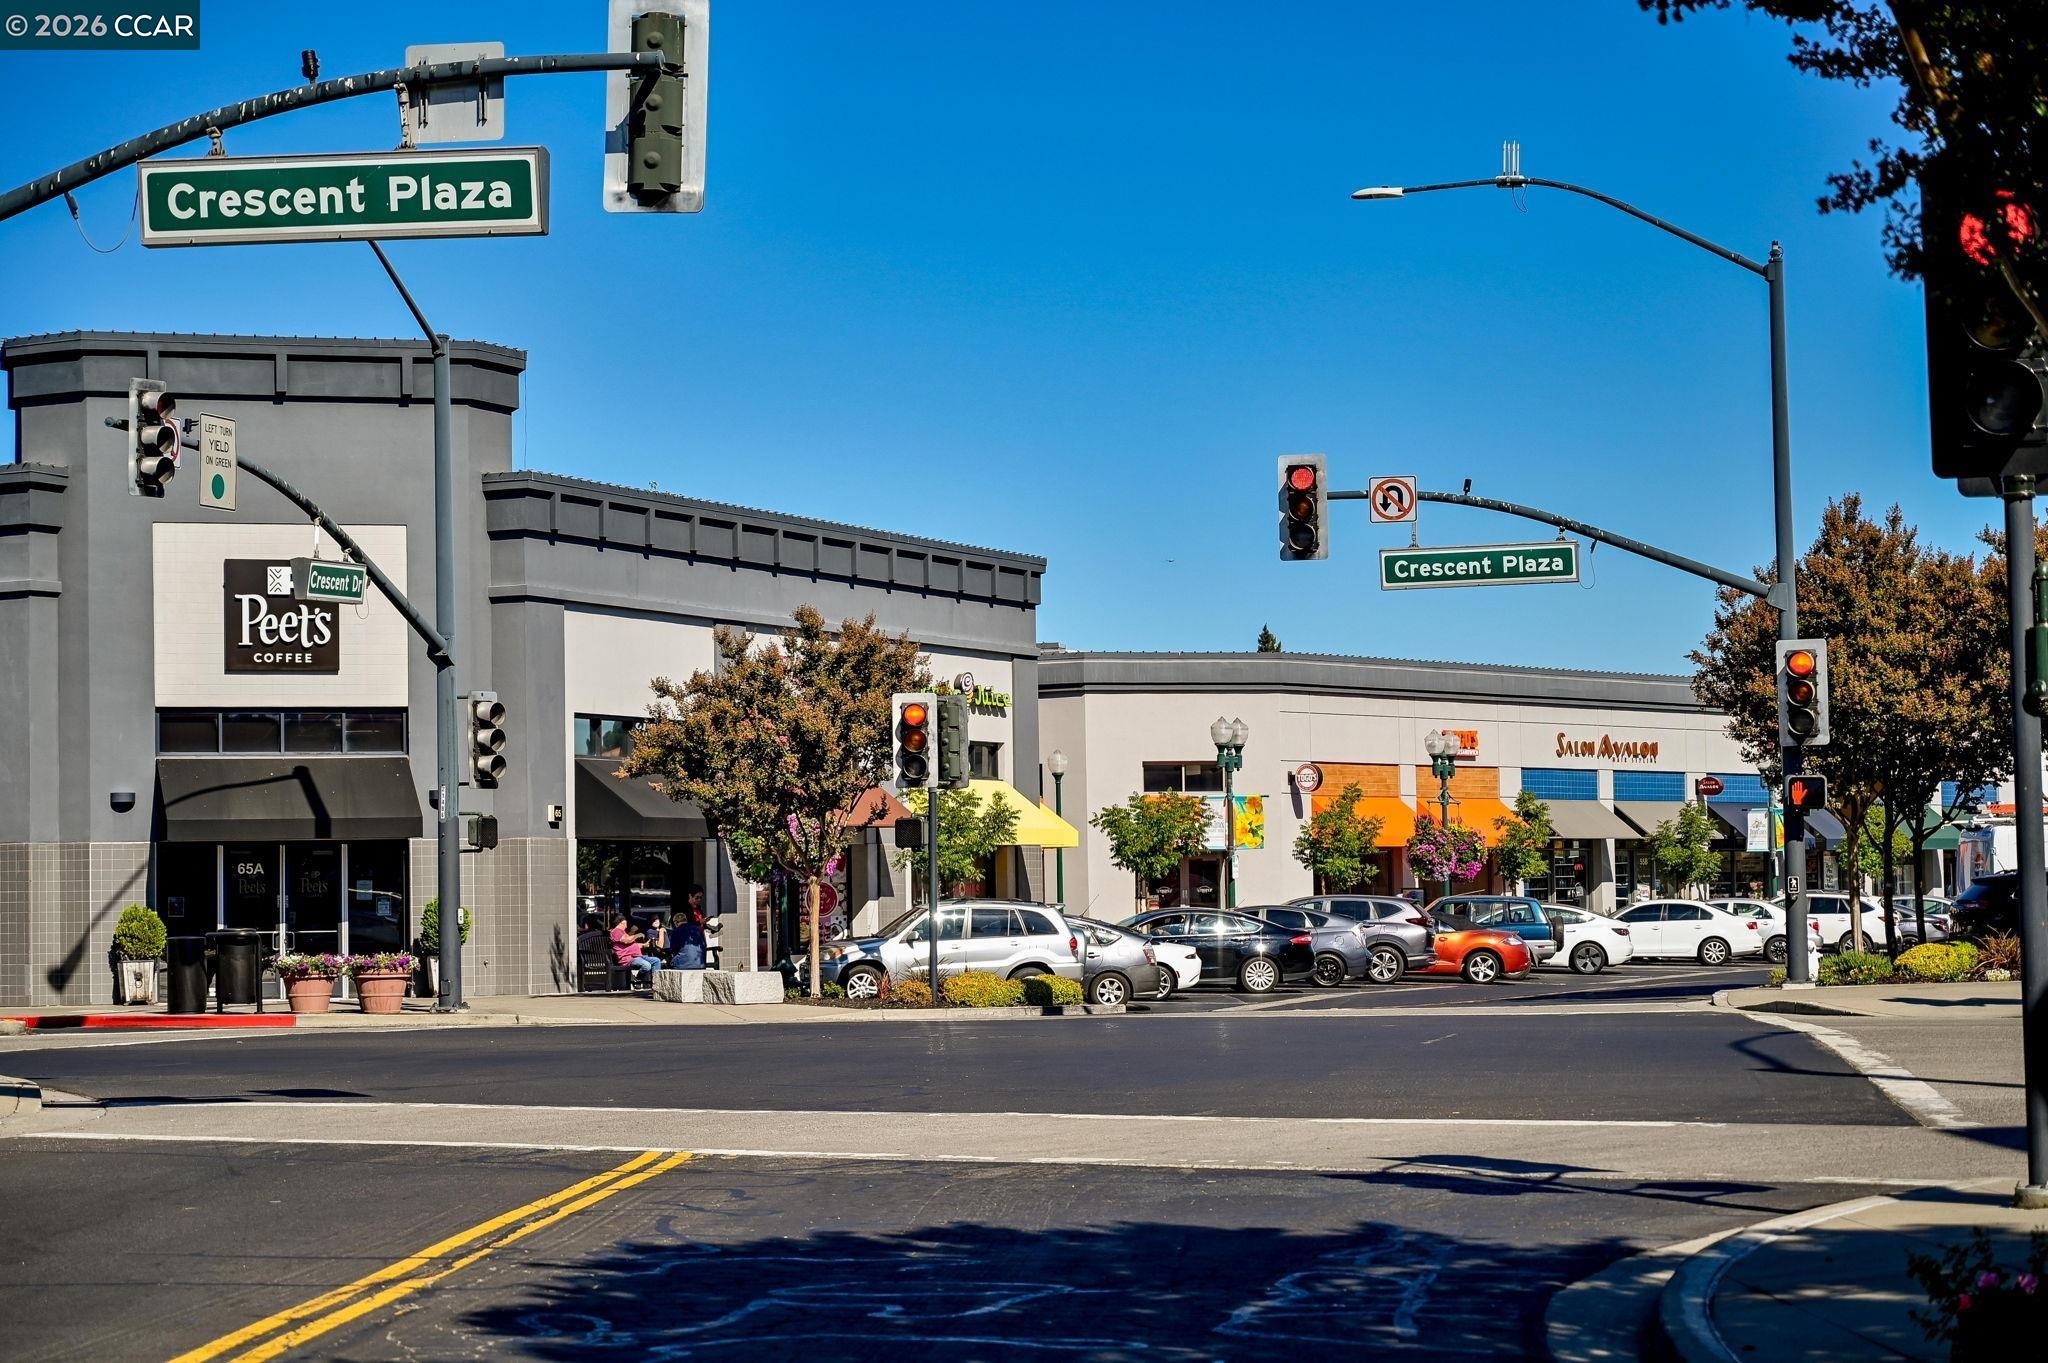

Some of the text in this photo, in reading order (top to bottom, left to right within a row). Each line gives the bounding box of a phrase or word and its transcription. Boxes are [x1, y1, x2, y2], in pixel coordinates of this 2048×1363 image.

[167, 174, 513, 220] Crescent Plaza
[204, 423, 233, 437] LEFT TURN
[208, 438, 230, 453] YIELD
[205, 455, 232, 469] ON GREEN
[1394, 555, 1564, 578] Crescent Plaza
[310, 570, 363, 593] Crescent Dr
[234, 593, 332, 648] Peet's
[253, 652, 313, 663] COFFEE
[237, 863, 265, 875] 65A
